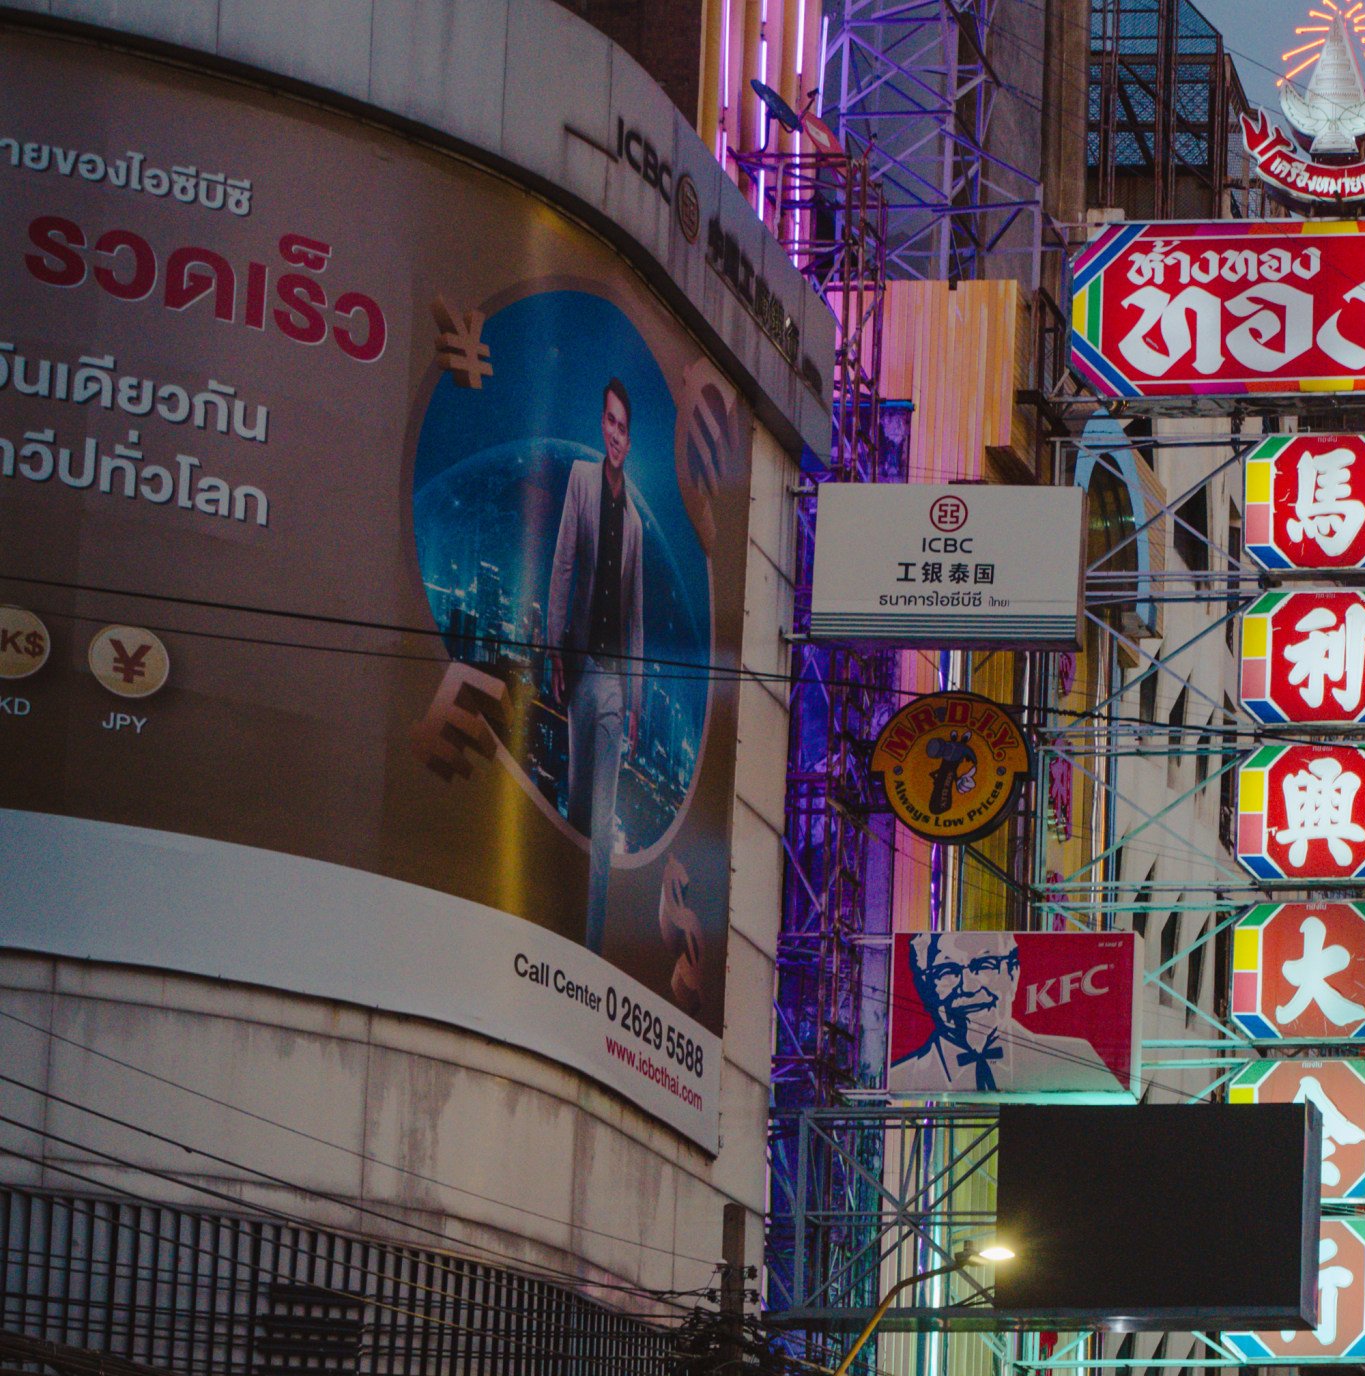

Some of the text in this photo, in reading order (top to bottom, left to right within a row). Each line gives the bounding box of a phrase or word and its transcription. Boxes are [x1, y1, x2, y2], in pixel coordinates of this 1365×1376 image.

[617, 117, 671, 207] ICBC
[24, 214, 388, 363] รวดเร็ว
[1127, 240, 1321, 285] ห้างทอง
[0, 342, 269, 442] ันเดียวกัน
[922, 537, 973, 553] ICBC
[879, 591, 982, 608] ธนาคารไอซีบีซี
[896, 562, 995, 585] 工银泰国
[102, 711, 148, 734] JPY
[894, 779, 1004, 830] Always Low Prices
[1024, 962, 1110, 1016] KFC
[513, 954, 704, 1079] Call Center 0 2629 5588
[606, 1035, 704, 1112] www.icbcthai.com
